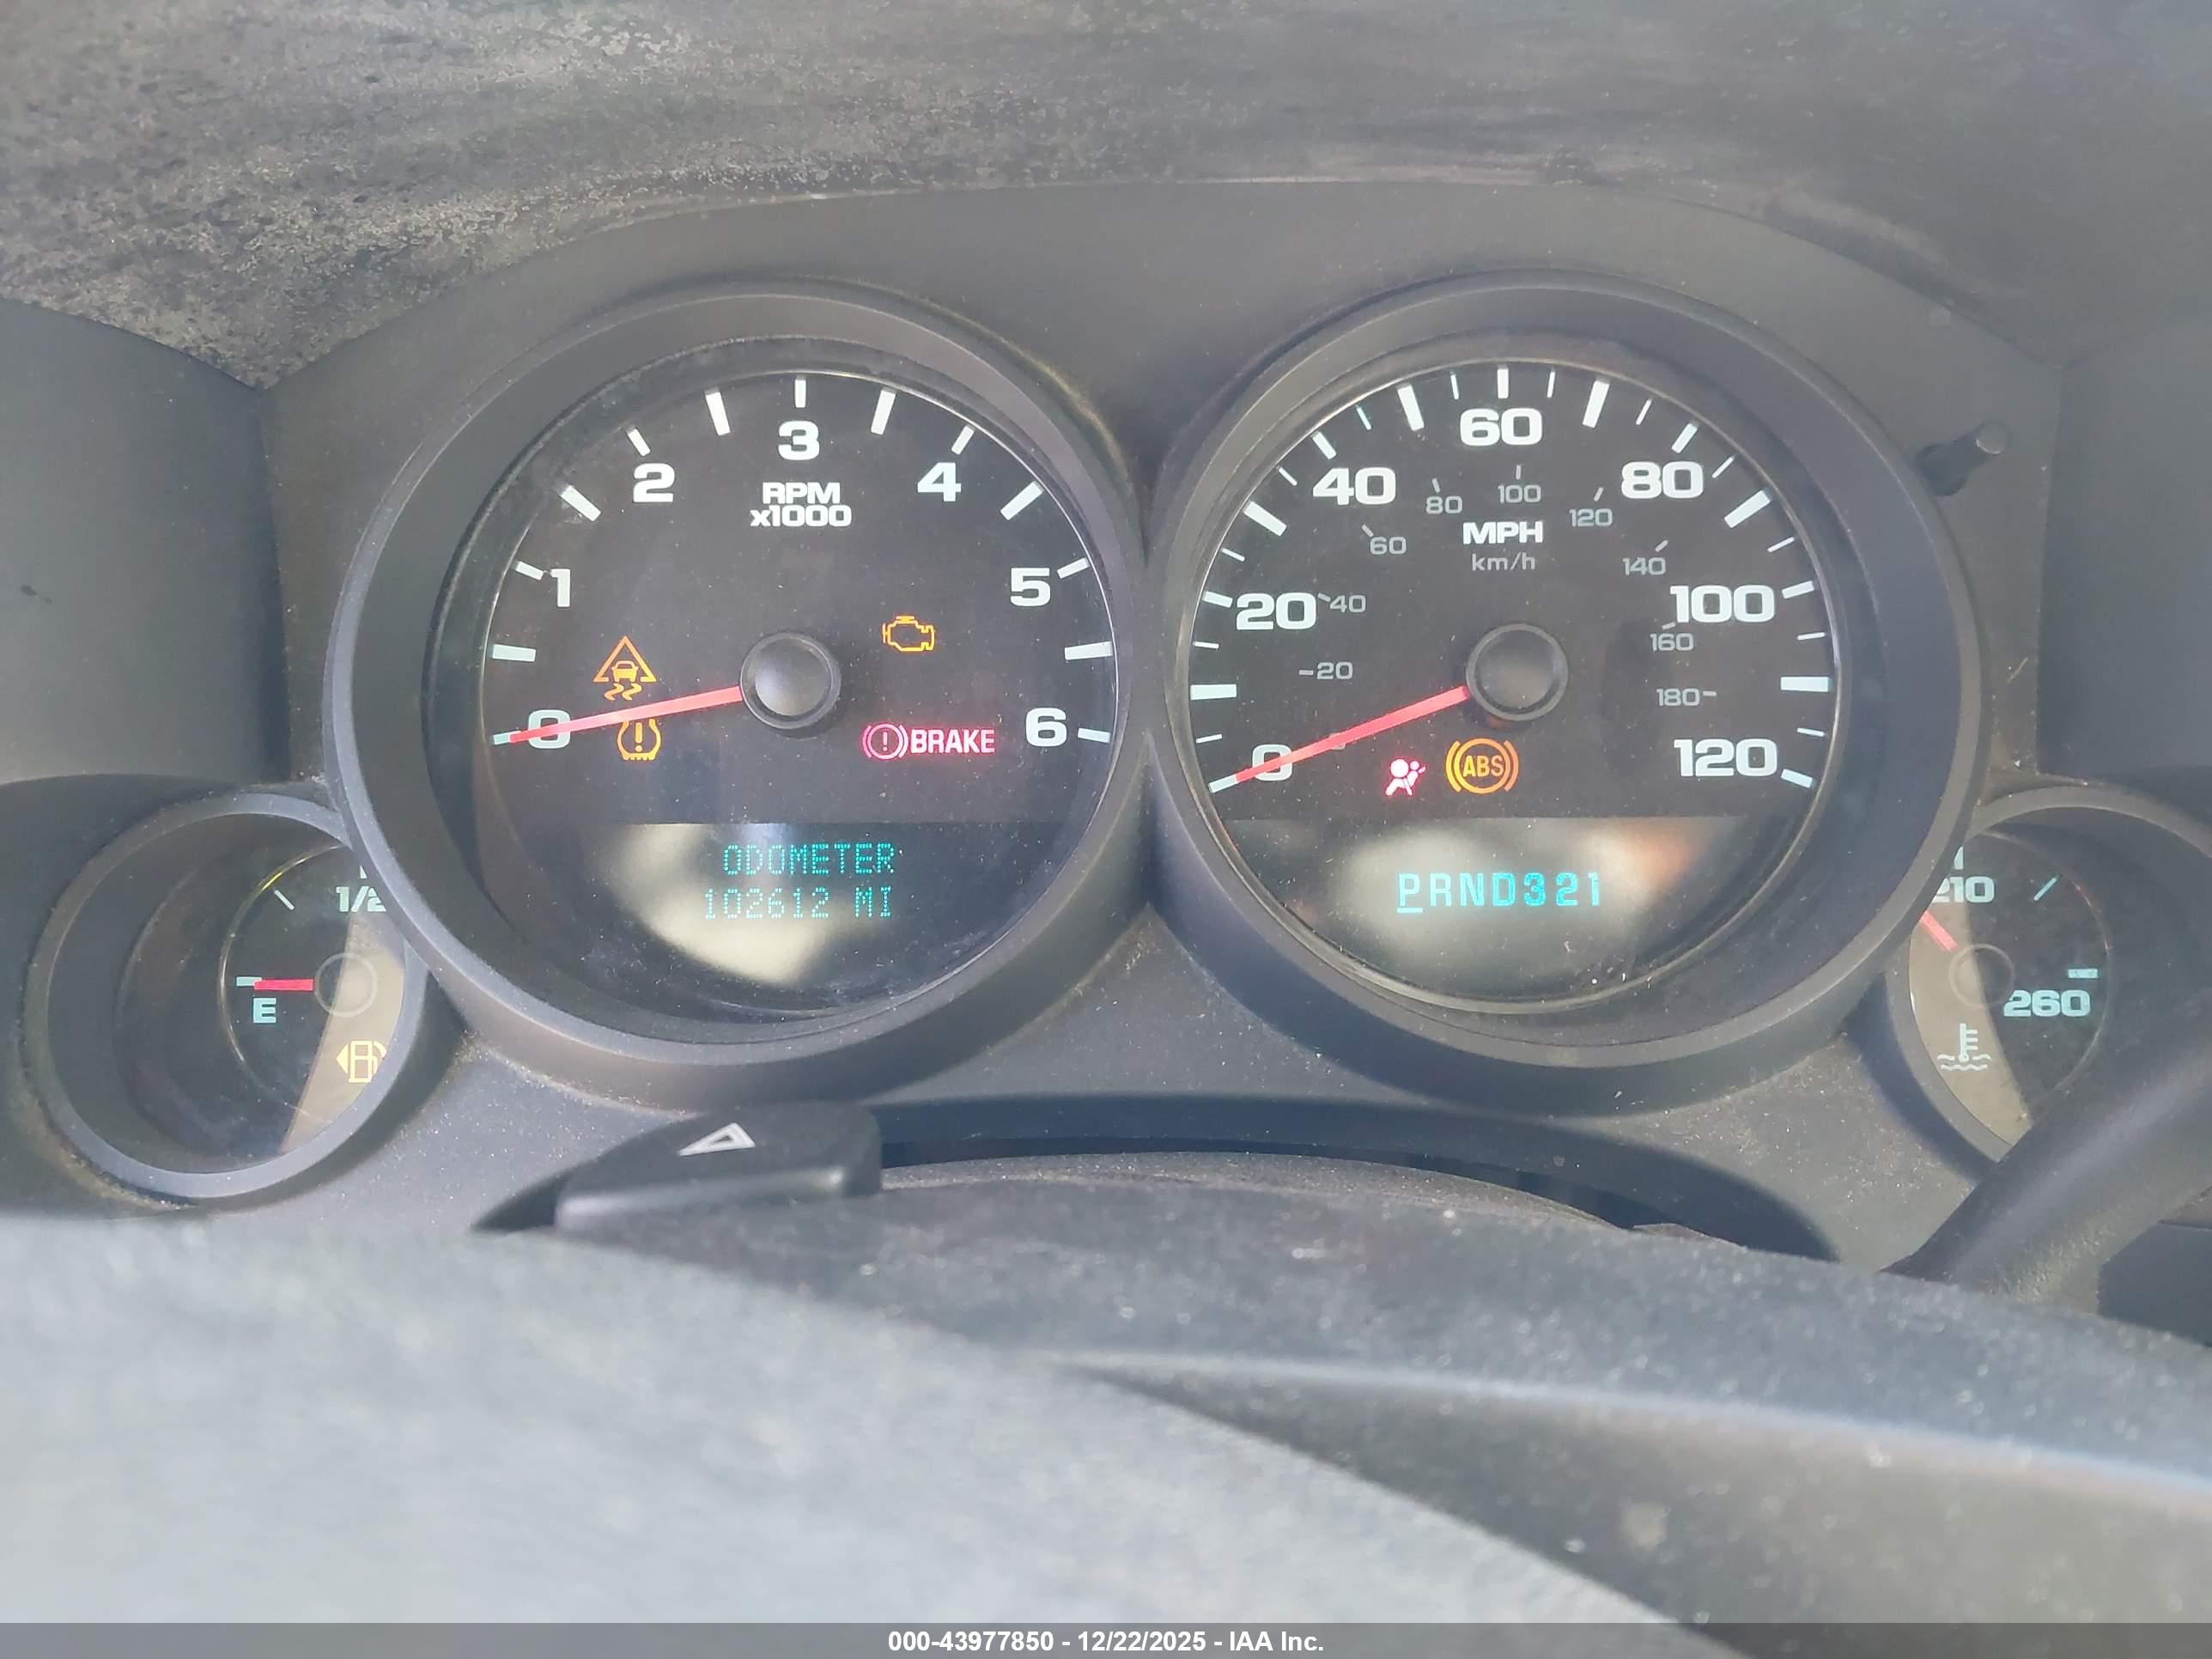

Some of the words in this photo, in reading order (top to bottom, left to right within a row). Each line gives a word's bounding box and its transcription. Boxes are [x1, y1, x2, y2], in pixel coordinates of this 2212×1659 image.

[778, 420, 820, 460] 3
[1460, 408, 1542, 447] 60
[633, 463, 675, 502] 2
[763, 482, 841, 504] RPM
[917, 462, 962, 501] 4
[1313, 467, 1396, 505] 40
[1498, 484, 1541, 503] 100
[1621, 461, 1704, 499] 80
[750, 505, 852, 526] x1000
[1425, 495, 1462, 514] 80
[1569, 508, 1613, 526] 120
[1370, 537, 1407, 555] 60
[1462, 521, 1544, 544] MPH
[1472, 552, 1535, 571] km/h
[1622, 557, 1666, 575] 140
[550, 568, 571, 608] 1
[1010, 567, 1051, 606] 5
[1236, 592, 1316, 630] 20
[1329, 595, 1366, 612] 40
[1669, 585, 1775, 623] 100
[1650, 633, 1694, 652] 160
[1316, 662, 1353, 679] 20
[1656, 688, 1700, 707] 180
[527, 709, 570, 749] 0
[910, 729, 994, 753] BRAKE
[1025, 708, 1067, 747] 6
[1252, 744, 1293, 781] 0
[1462, 754, 1504, 778] ABS
[1674, 738, 1778, 777] 120
[723, 842, 896, 875] ODOMETER
[705, 887, 830, 920] 102612
[854, 885, 891, 918] MI
[253, 997, 276, 1023] E
[2003, 990, 2090, 1017] 260
